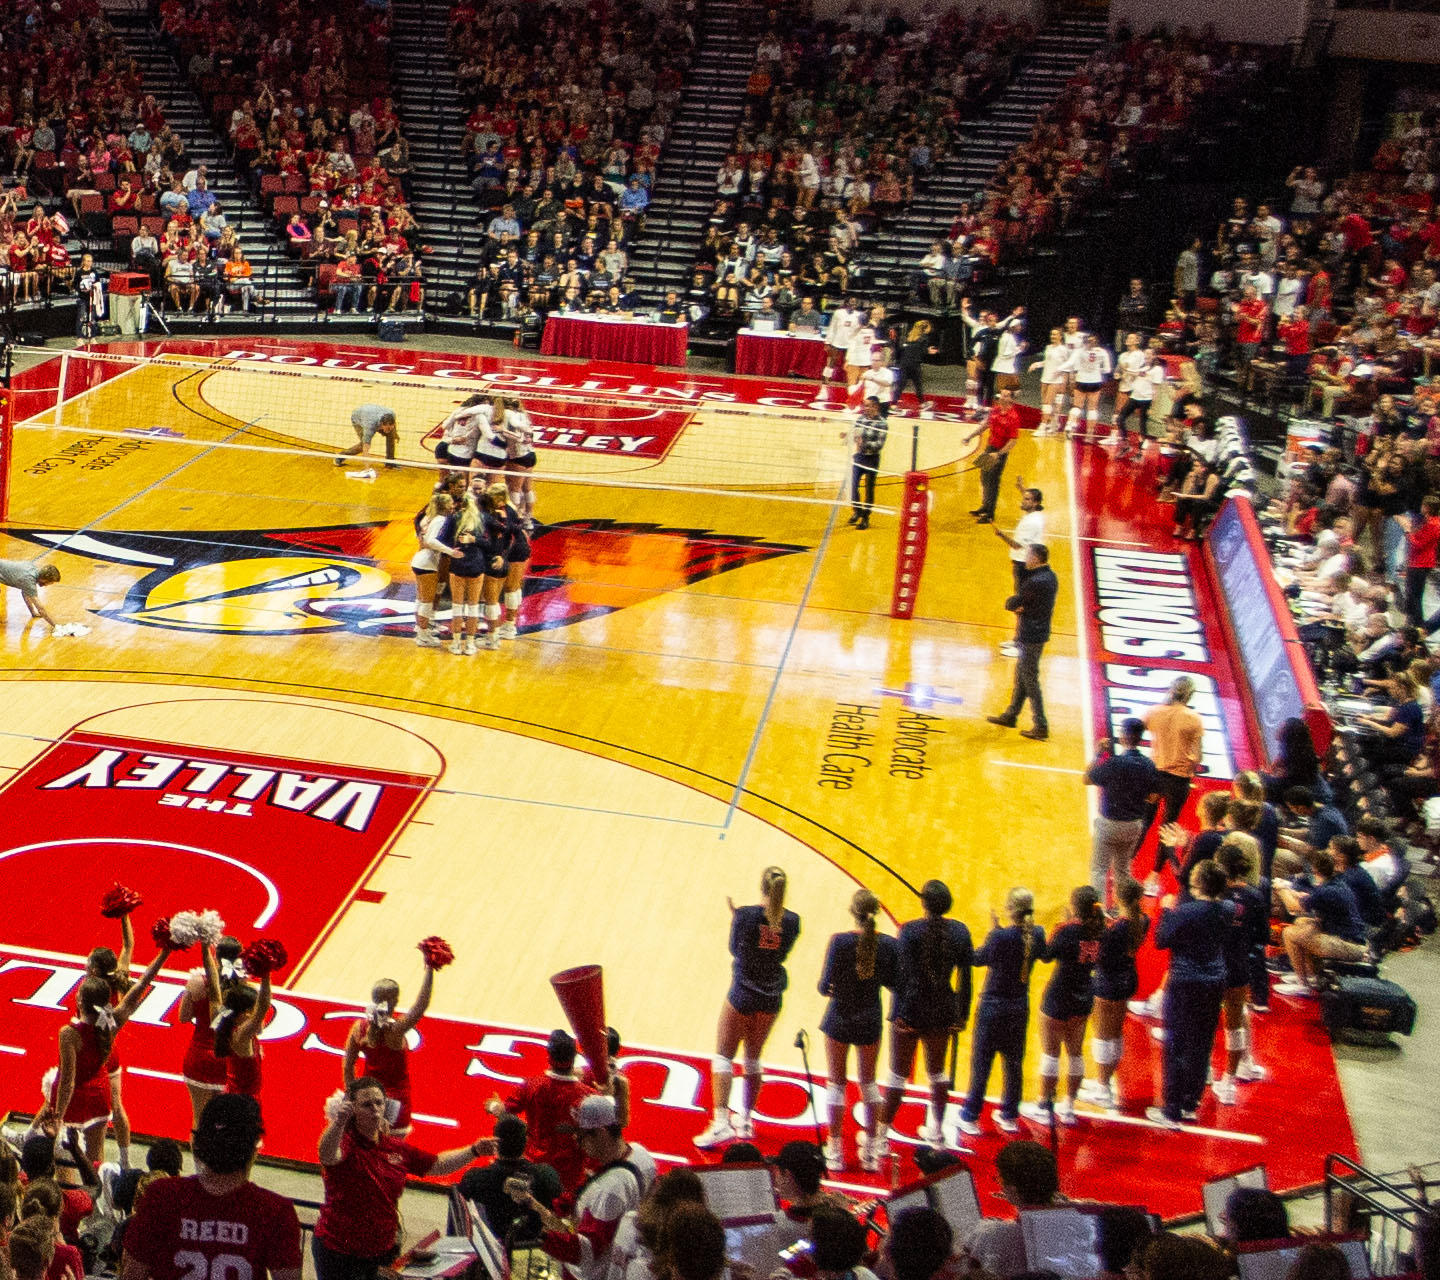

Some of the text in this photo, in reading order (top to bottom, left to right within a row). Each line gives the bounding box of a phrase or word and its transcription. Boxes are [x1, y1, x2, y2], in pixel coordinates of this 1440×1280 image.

[222, 349, 417, 379] DOUG
[430, 370, 742, 406] COLLINS
[81, 439, 153, 472] Advocate
[524, 433, 657, 453] LLEY
[896, 501, 920, 613] REDBIRDS
[1094, 547, 1211, 663] ILLINOIS
[817, 702, 879, 791] Health Care
[888, 710, 947, 781] Advocate
[41, 747, 385, 833] VALLEY
[157, 792, 256, 818] THE
[178, 1217, 251, 1247] REED
